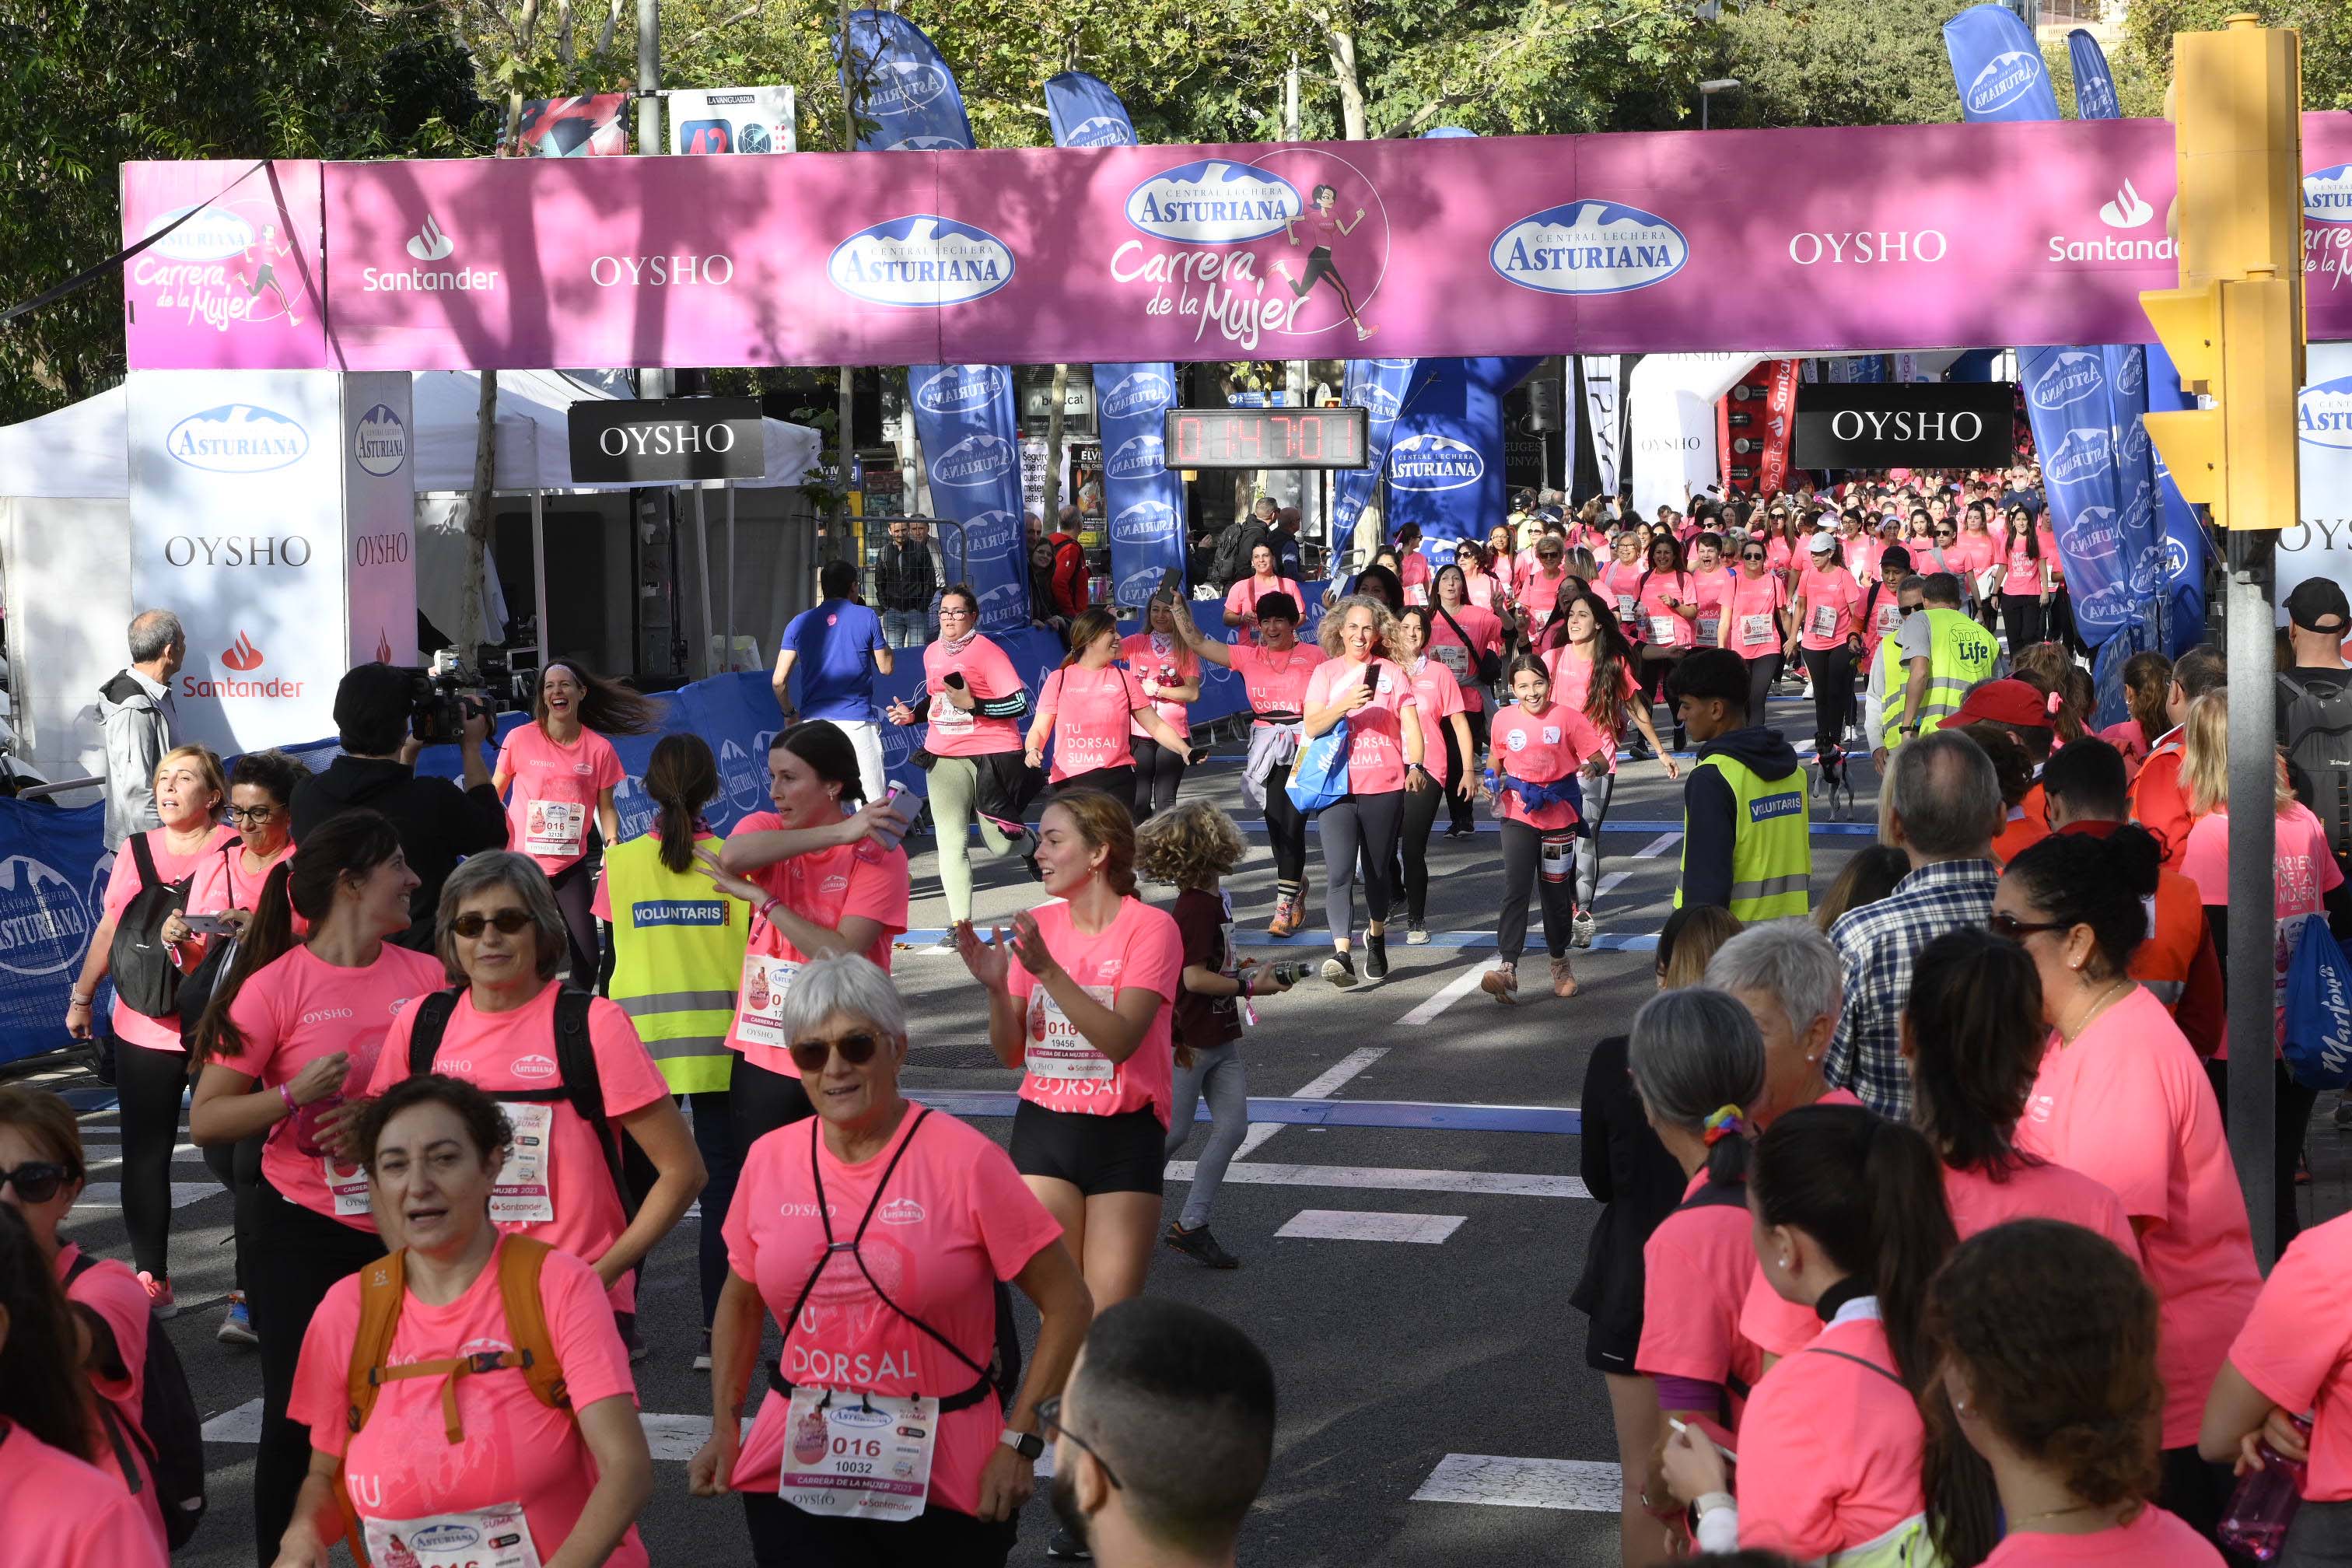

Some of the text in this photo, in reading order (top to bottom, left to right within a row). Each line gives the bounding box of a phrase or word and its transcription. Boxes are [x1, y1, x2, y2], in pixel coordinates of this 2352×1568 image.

[1166, 187, 1283, 198] CENTRAL LECHERA
[1139, 191, 1288, 223] ASTURIANA
[1536, 230, 1666, 243] CENTRAL LECHERA
[870, 244, 994, 257] CENTRAL LECHERA
[1505, 236, 1672, 272] ASTURIANA
[1789, 229, 1947, 265] OYSHO
[844, 246, 1000, 284] ASTURIANA
[1110, 240, 1262, 283] Carrera
[2322, 250, 2336, 272] la
[134, 257, 227, 287] Carrera
[590, 254, 733, 287] OYSHO
[363, 266, 499, 292] Santander
[156, 283, 261, 332] de la Mujer
[1146, 276, 1311, 351] de la Mujer
[1832, 410, 1983, 442] OYSHO
[178, 429, 298, 457] ASTURIANA
[358, 432, 404, 460] ASTURIANA
[599, 424, 735, 458] OYSHO
[1178, 417, 1353, 460] 01:47:01
[1642, 436, 1700, 451] OYSHO
[1024, 464, 1036, 473] que
[1389, 460, 1477, 479] ASTURIANA
[1764, 440, 1783, 492] Sports
[1024, 493, 1039, 502] este
[165, 536, 312, 567] OYSHO
[356, 532, 408, 567] OYSHO
[1951, 628, 1981, 642] Sport
[1958, 642, 1989, 664] Life
[182, 677, 305, 698] Santander
[1251, 687, 1266, 698] TU
[1255, 701, 1300, 712] DORSAL
[1066, 723, 1081, 733] TU
[1067, 737, 1118, 748] DORSAL
[530, 759, 555, 768] OYSHO
[1068, 752, 1104, 763] SUMA
[1350, 754, 1382, 765] UMA
[1752, 797, 1801, 817] VOLUNTARIS
[547, 822, 565, 831] 016
[2280, 871, 2313, 887] DE LA
[635, 907, 721, 922] VOLUNTARIS
[303, 1007, 352, 1024] OYSHO
[751, 1017, 774, 1026] CARRERA
[747, 1027, 773, 1039] OYSHO
[1048, 1021, 1079, 1036] 016
[1052, 1039, 1075, 1048] 19456
[514, 1063, 554, 1073] ASTURIANA
[343, 1185, 368, 1193] CARRER
[501, 1202, 542, 1211] Santander
[781, 1203, 837, 1218] OYSHO
[793, 1345, 917, 1383] DORSAL
[832, 1437, 881, 1457] 016
[835, 1461, 873, 1474] 10032
[349, 1474, 381, 1508] TU
[796, 1476, 834, 1486] CARRERA
[862, 1480, 890, 1489] MUJER
[893, 1483, 913, 1493] 2023
[793, 1493, 835, 1506] OYSHO
[869, 1499, 913, 1512] Santander
[482, 1517, 514, 1530] SUMA
[416, 1533, 474, 1547] ASTURIANA
